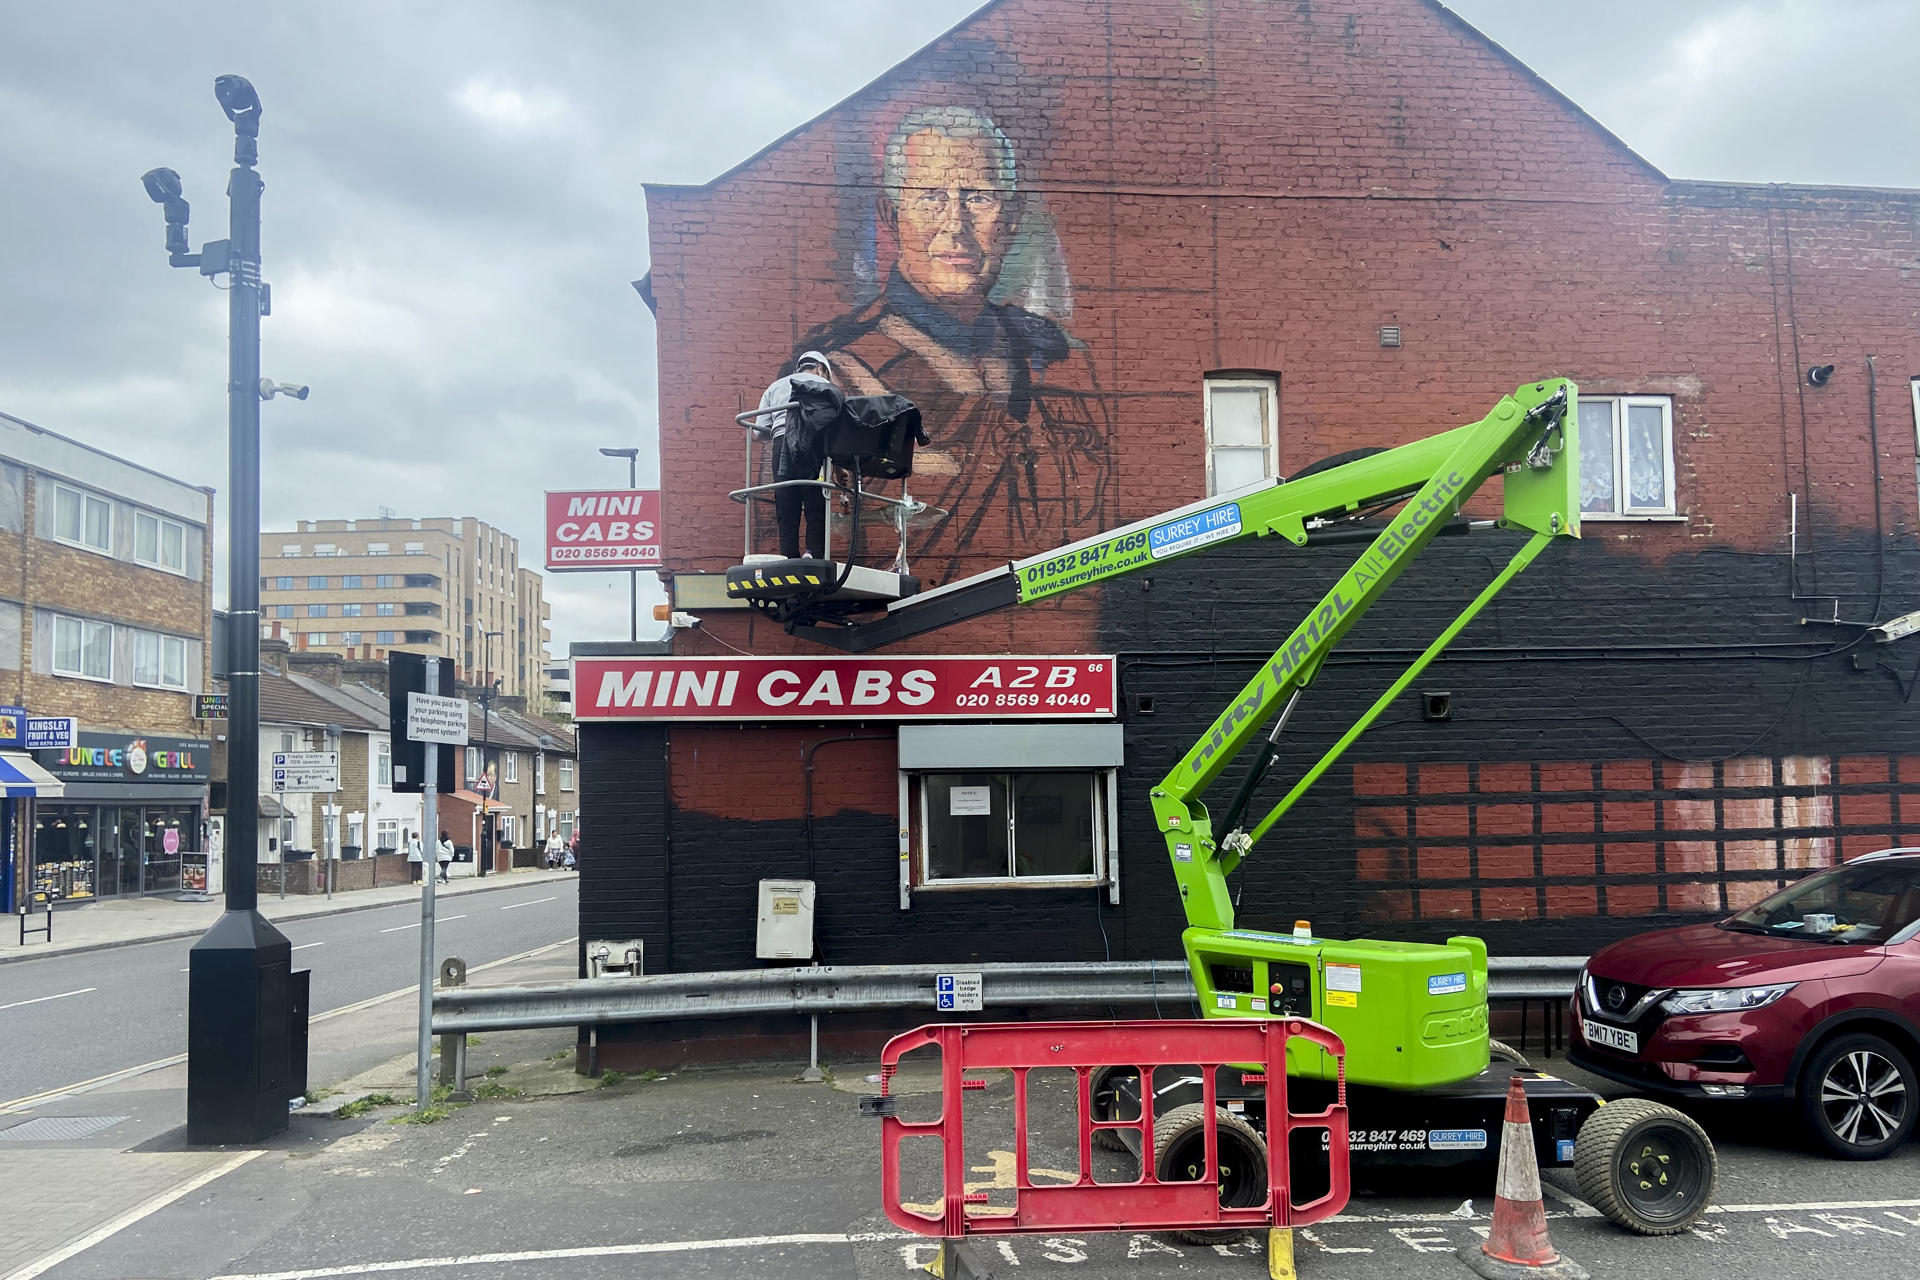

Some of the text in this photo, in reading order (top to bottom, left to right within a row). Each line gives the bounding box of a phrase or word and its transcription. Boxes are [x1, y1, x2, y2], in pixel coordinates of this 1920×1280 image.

[568, 496, 643, 517] MINI
[556, 521, 654, 542] CABS
[1154, 507, 1236, 545] SURREY HIRE
[555, 547, 655, 558] 020 8569 4040
[1027, 532, 1147, 583] 01932 847 469
[1029, 551, 1149, 596] www.surreyhire.co.uk
[1192, 470, 1464, 773] nifty HR12L All-Electric
[1088, 663, 1104, 673] 66
[970, 666, 1078, 688] A2B
[595, 670, 937, 708] MINI CABS
[416, 696, 429, 705] Have
[956, 694, 1091, 707] 020 8569 4040
[428, 708, 448, 718] parking
[29, 721, 68, 731] KINGSLEY
[410, 715, 466, 730] the telephone parking
[27, 731, 69, 740] FRUIT & VEG
[416, 727, 439, 735] payment
[58, 747, 122, 767] JUNGLE
[157, 751, 195, 768] GRILL
[1430, 976, 1453, 988] SURREY
[1588, 1022, 1631, 1048] BM17 YBE
[1321, 1130, 1427, 1143] 032 847 469
[1432, 1131, 1483, 1141] SURREY HIRE
